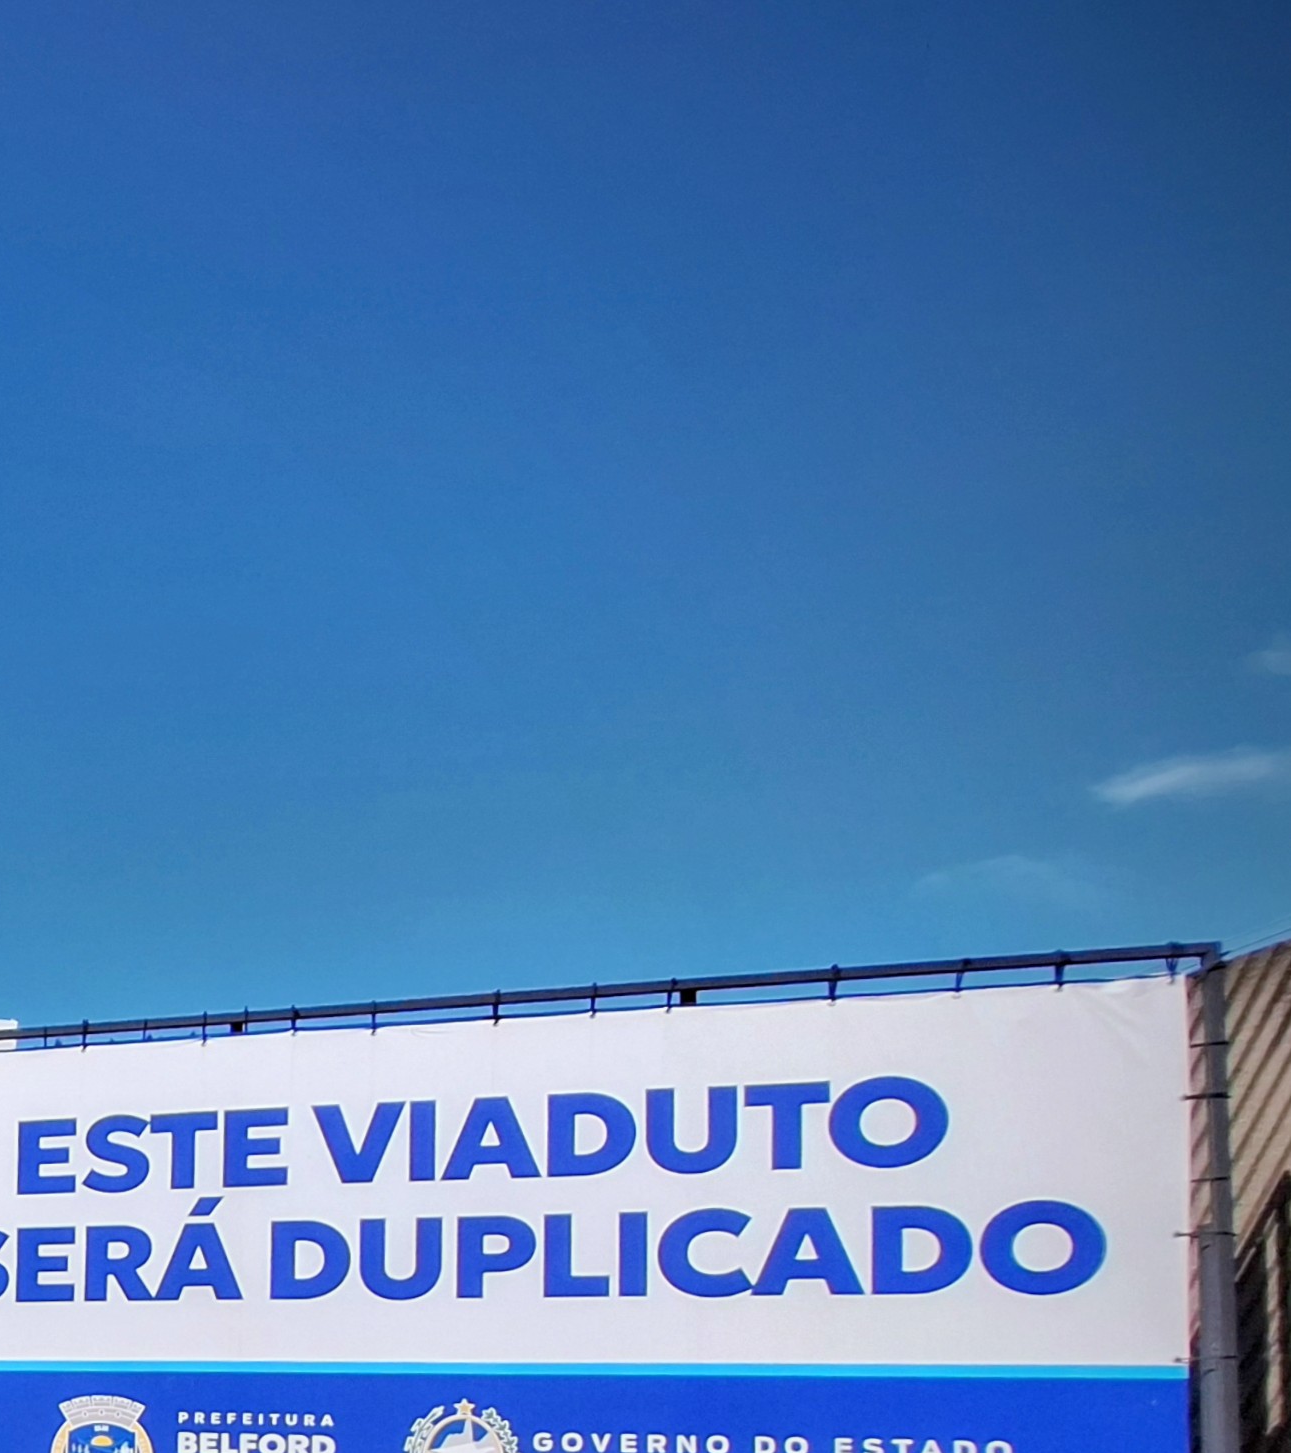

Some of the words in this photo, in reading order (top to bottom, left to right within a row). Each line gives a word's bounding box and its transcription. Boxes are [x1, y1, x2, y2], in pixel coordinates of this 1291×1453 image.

[17, 1107, 289, 1195] ESTE
[311, 1076, 949, 1184] VIADUTO
[269, 1199, 1108, 1301] DUPLICADO
[177, 1411, 335, 1427] PREFEITURA
